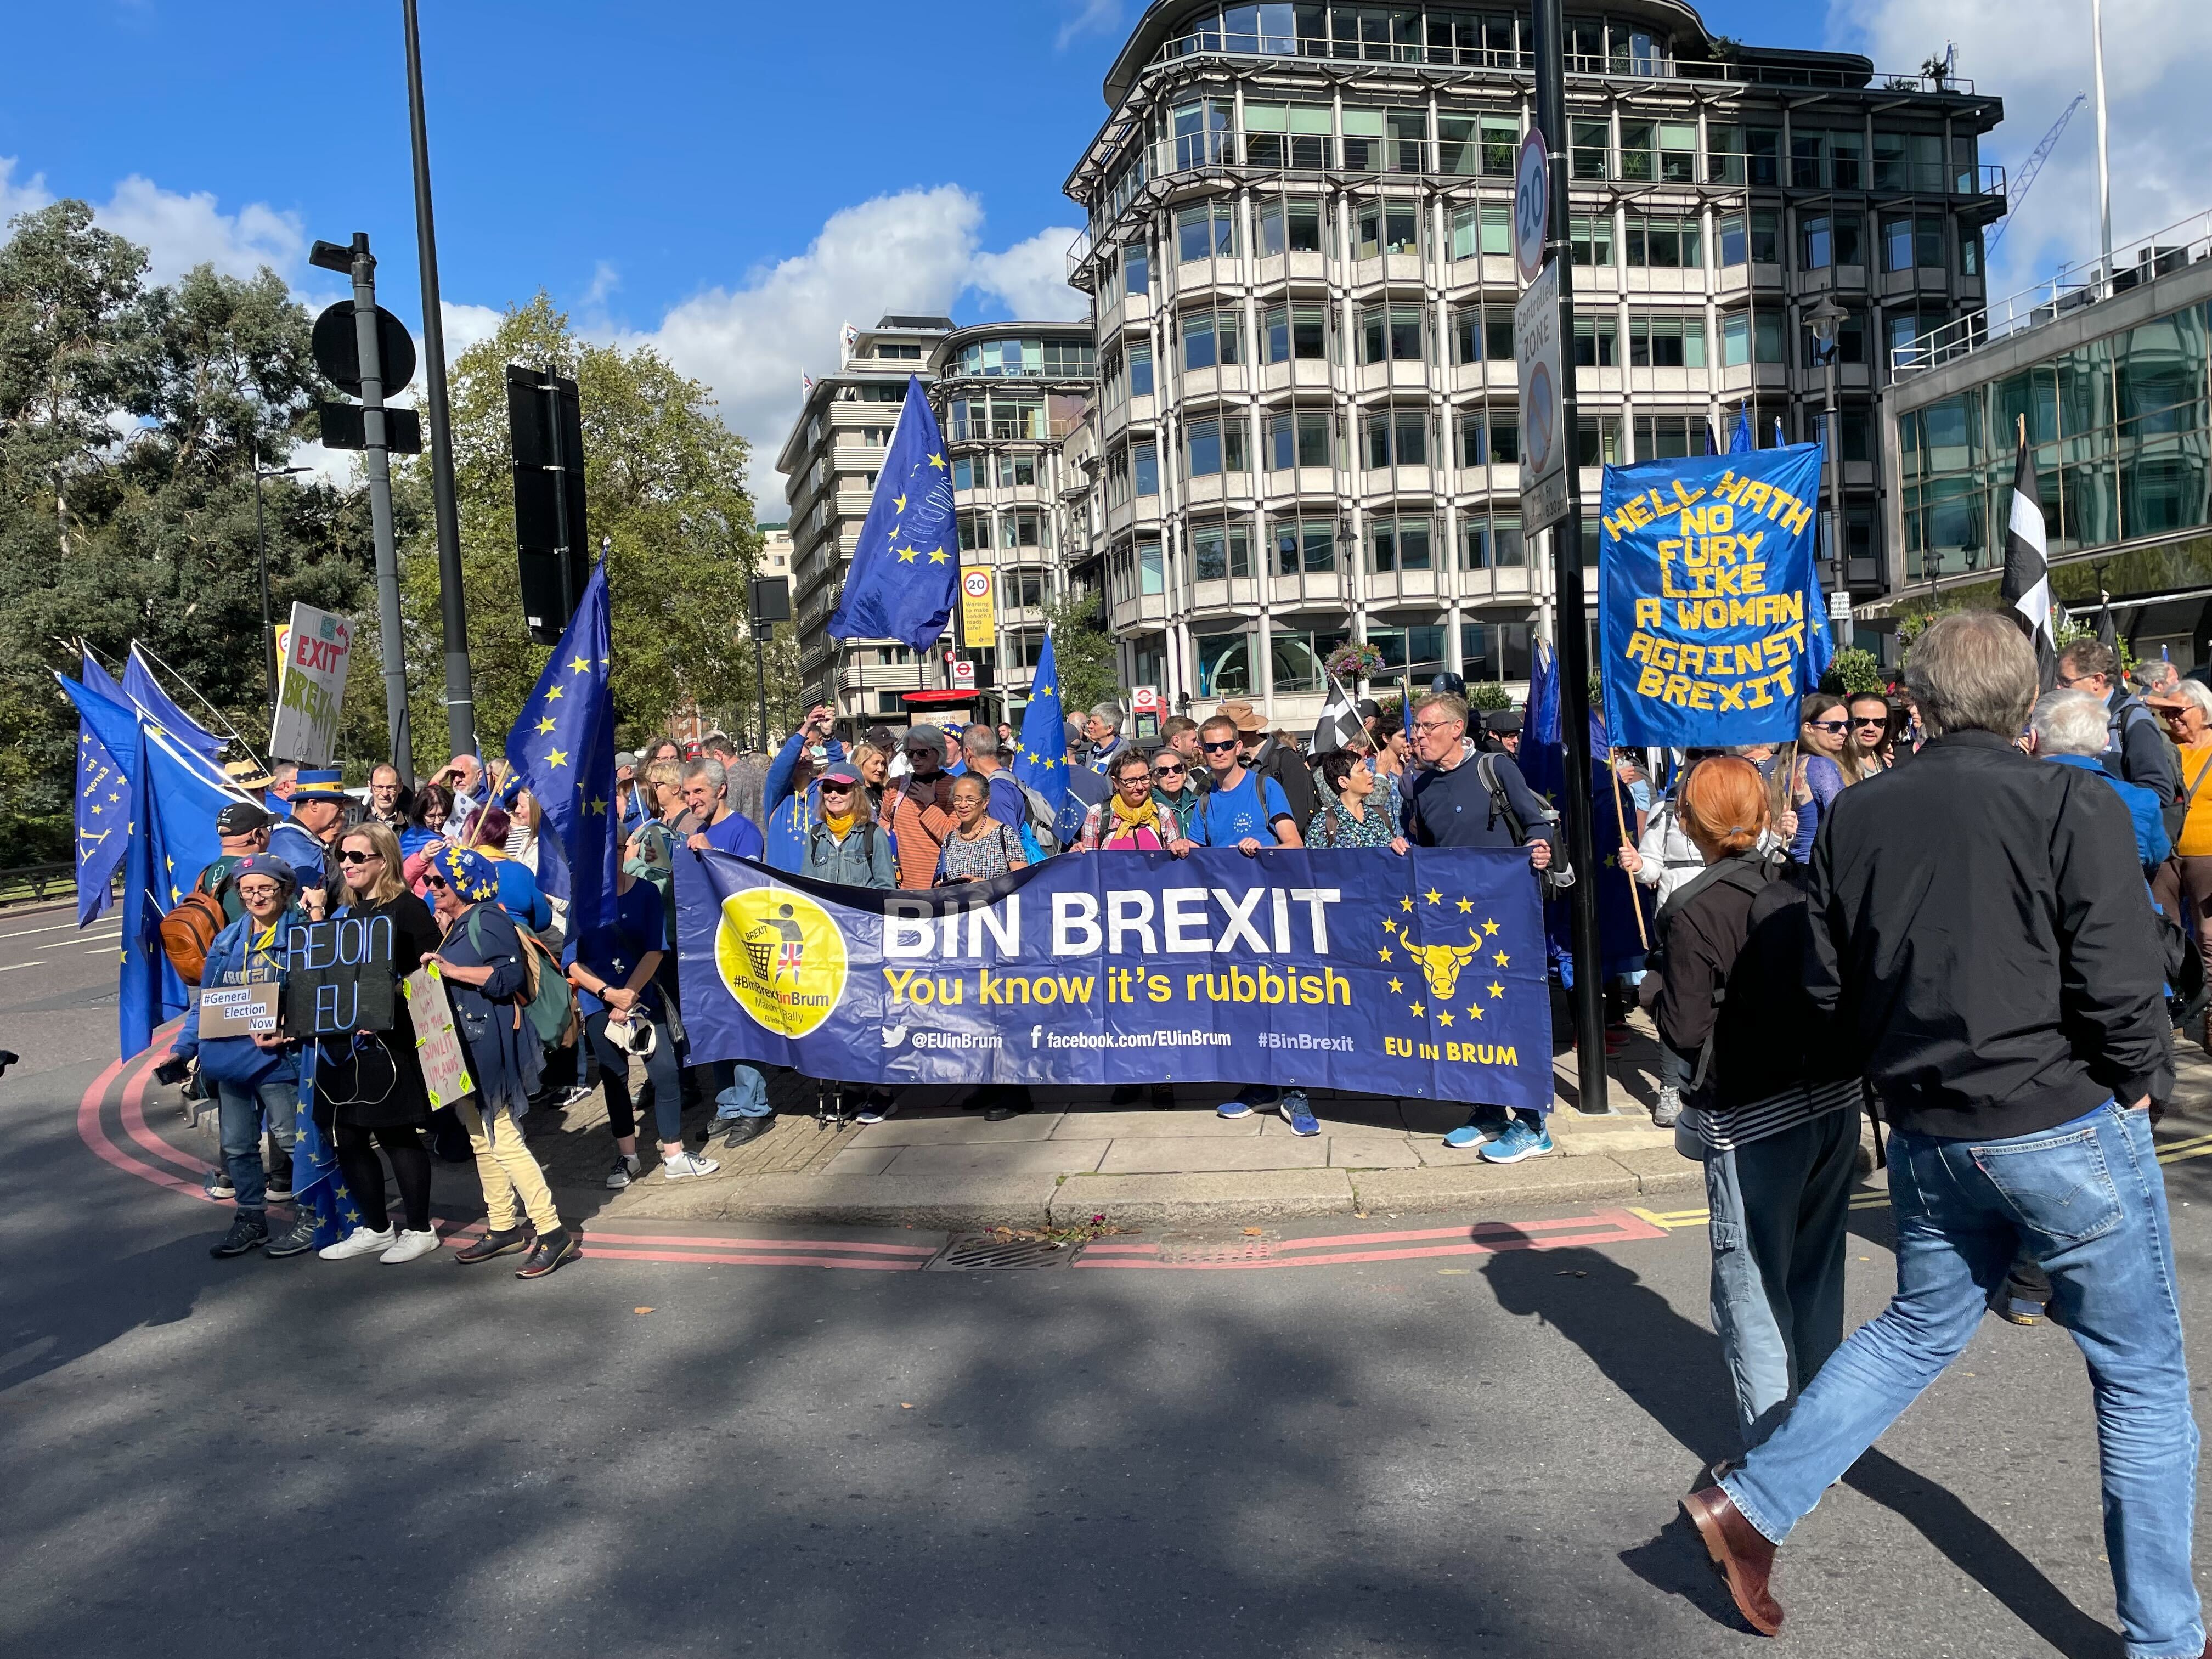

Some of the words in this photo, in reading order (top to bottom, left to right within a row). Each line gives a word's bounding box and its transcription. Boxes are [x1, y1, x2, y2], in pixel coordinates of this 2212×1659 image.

[1520, 166, 1543, 247] 20
[1517, 273, 1554, 332] Controlled
[1524, 314, 1549, 364] ZONE
[1602, 479, 1706, 542] HELL
[1712, 470, 1813, 535] HATH
[1680, 505, 1734, 535] NO
[1658, 531, 1763, 570] FURY
[968, 579, 985, 590] 20
[1662, 562, 1766, 599] LIKE
[1635, 598, 1661, 628] A
[1677, 590, 1804, 630] WOMAN
[296, 635, 342, 674] EXIT
[947, 653, 953, 661] B
[1626, 620, 1805, 675] AGAINST
[1637, 665, 1795, 712] BREXIT
[283, 666, 338, 752] BREXIT
[745, 925, 768, 941] BREXIT
[883, 894, 1020, 957] BIN
[1052, 888, 1340, 956] BREXIT
[286, 915, 392, 972] REJOIN
[204, 989, 250, 1005] #General
[882, 969, 963, 1005] You
[979, 969, 1095, 1005] know
[1108, 967, 1172, 1003] it's
[1186, 966, 1351, 1006] rubbish
[224, 1005, 265, 1018] Election
[249, 1018, 274, 1029] Now
[315, 980, 358, 1032] EU
[782, 1009, 803, 1024] Rally
[424, 1032, 453, 1062] SUNLIT
[912, 1032, 1002, 1048] @EUinBrum
[1047, 1030, 1231, 1048] facebook.com/EUinBrum
[1258, 1032, 1354, 1052] #BinBrexit
[1385, 1037, 1413, 1058] EU
[1419, 1043, 1440, 1060] IN
[1446, 1042, 1519, 1066] BRUM
